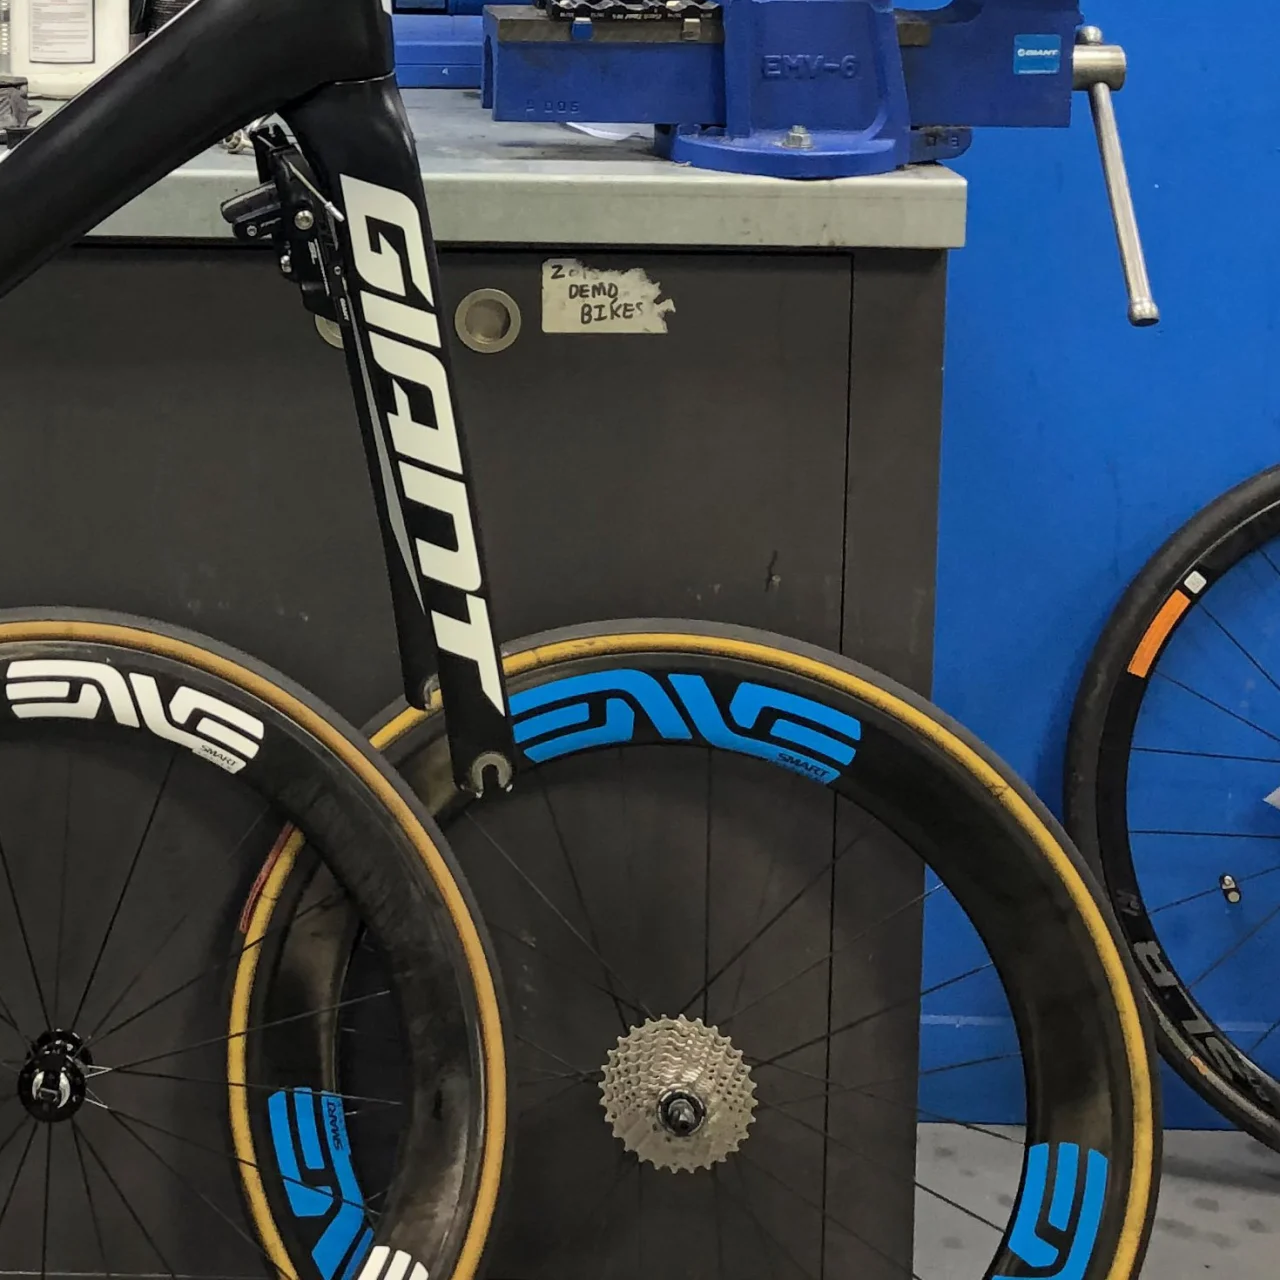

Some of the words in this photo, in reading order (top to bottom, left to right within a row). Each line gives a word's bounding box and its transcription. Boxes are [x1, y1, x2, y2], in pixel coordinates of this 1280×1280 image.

[569, 282, 618, 299] DEMO
[581, 299, 644, 324] BIKES
[339, 173, 506, 718] GIANT
[199, 743, 238, 766] SMART
[775, 751, 830, 778] SMART
[327, 1099, 342, 1151] SMART
